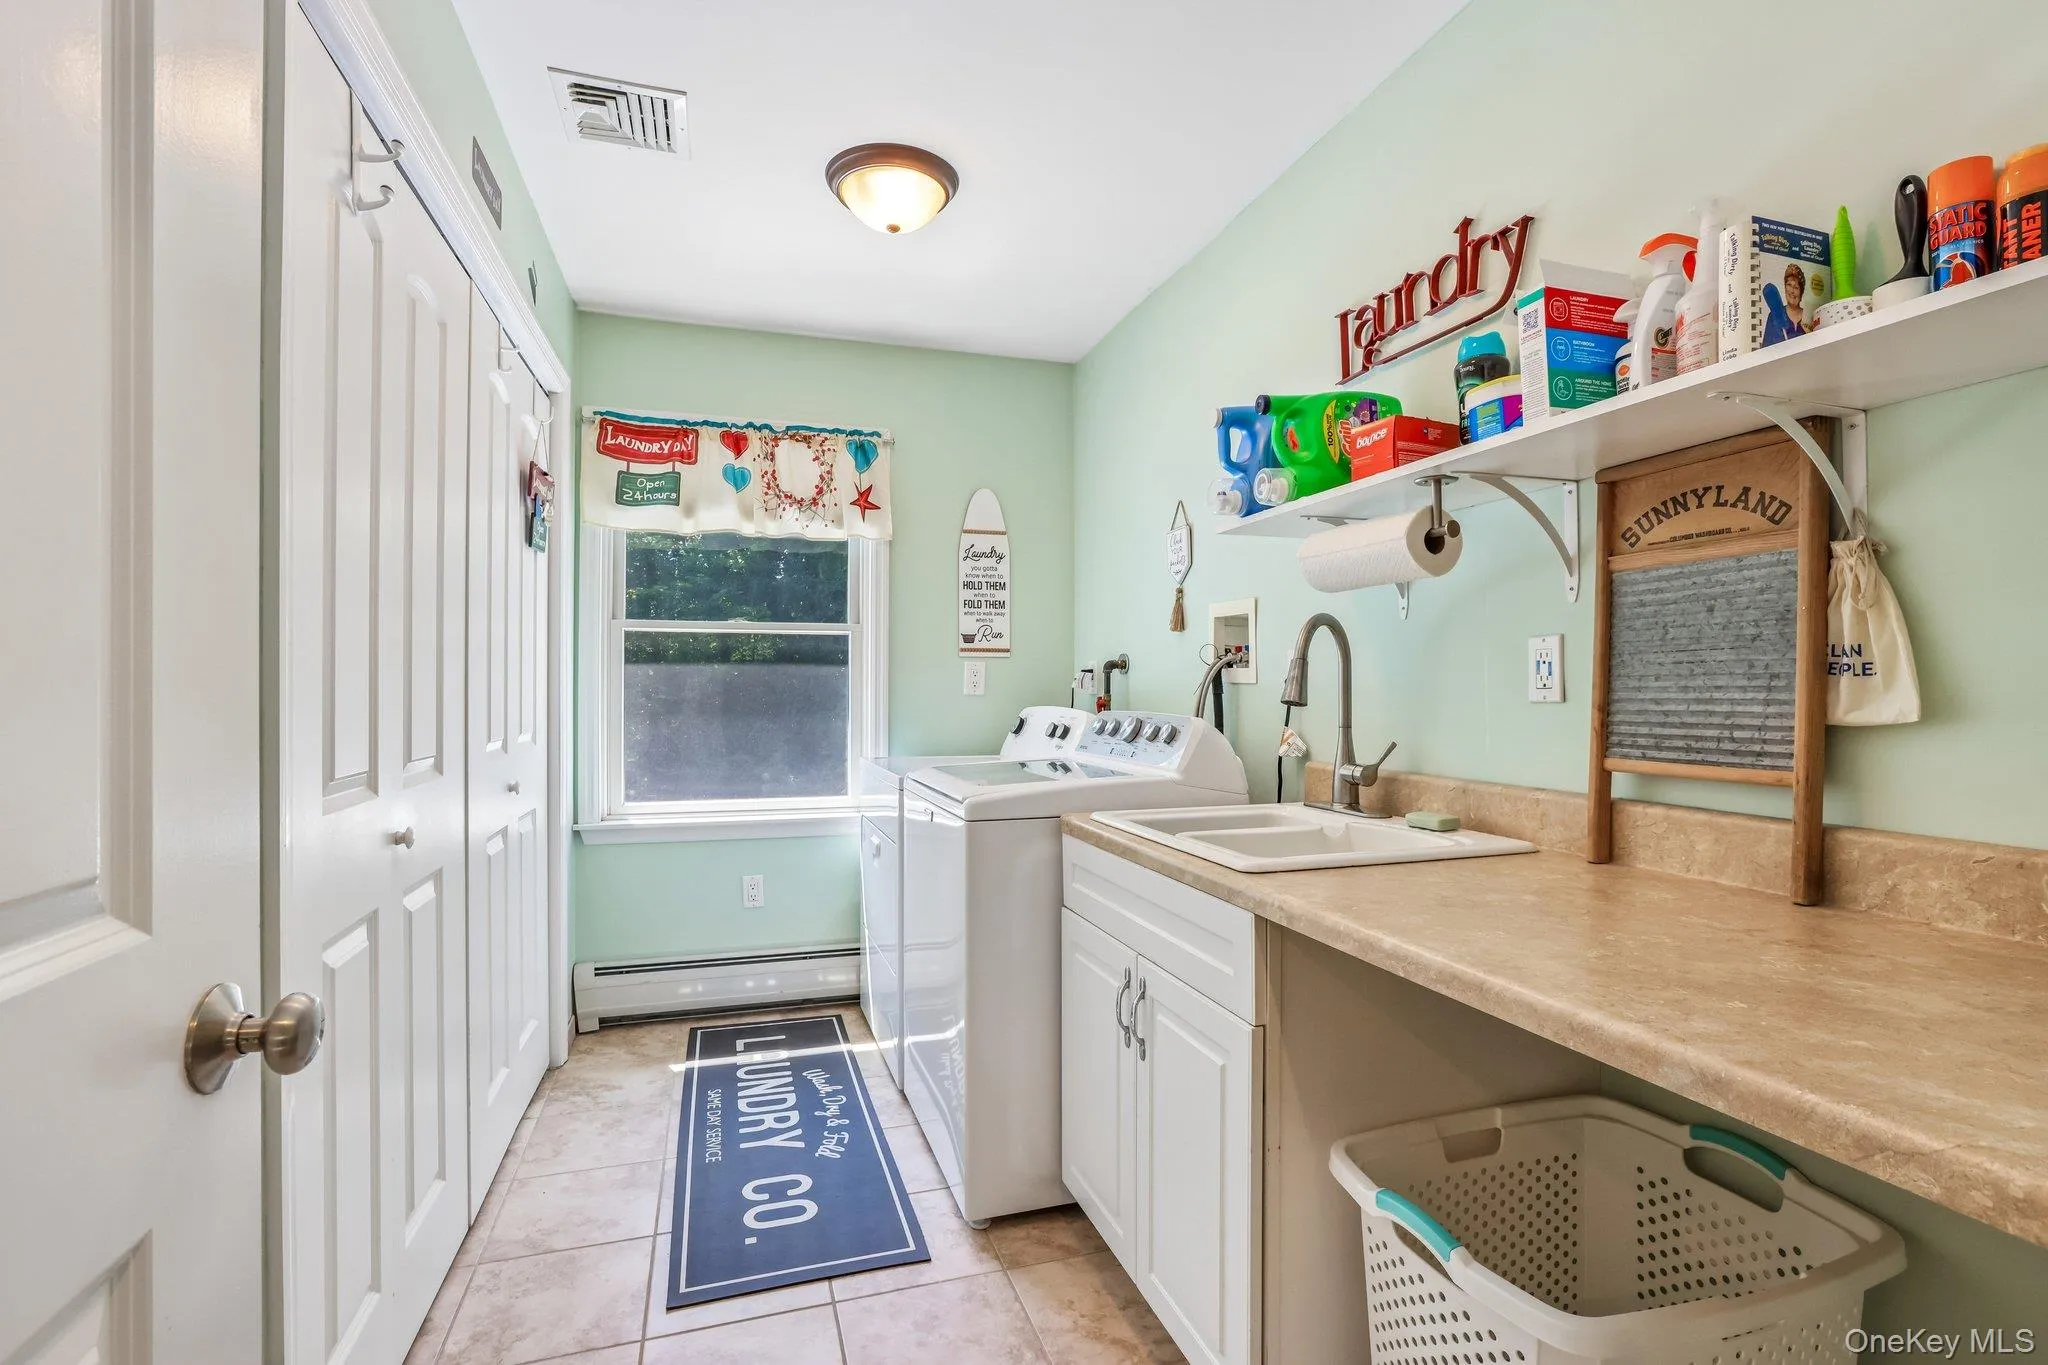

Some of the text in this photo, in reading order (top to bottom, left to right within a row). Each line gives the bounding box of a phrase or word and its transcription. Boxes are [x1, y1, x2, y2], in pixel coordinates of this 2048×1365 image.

[1928, 202, 1987, 236] STATIC
[1930, 220, 1987, 250] GUARD
[1728, 233, 1738, 275] Talking Dirty
[1335, 214, 1535, 386] laundry
[605, 426, 693, 454] LAUNDRY DAY
[1355, 427, 1389, 449] bounce
[637, 478, 665, 491] Open
[1621, 484, 1793, 549] SUNNYLAND
[963, 543, 1006, 564] Laundry
[963, 580, 1006, 591] HOLD THEM
[964, 599, 1005, 609] FOLD THEM
[977, 624, 1004, 642] Run
[814, 1095, 847, 1117] Dry
[705, 1088, 722, 1163] SAME DAY SERVICE
[826, 1118, 850, 1127] &
[735, 1034, 820, 1245] LAUNDRY CO.
[815, 1131, 850, 1159] Fold
